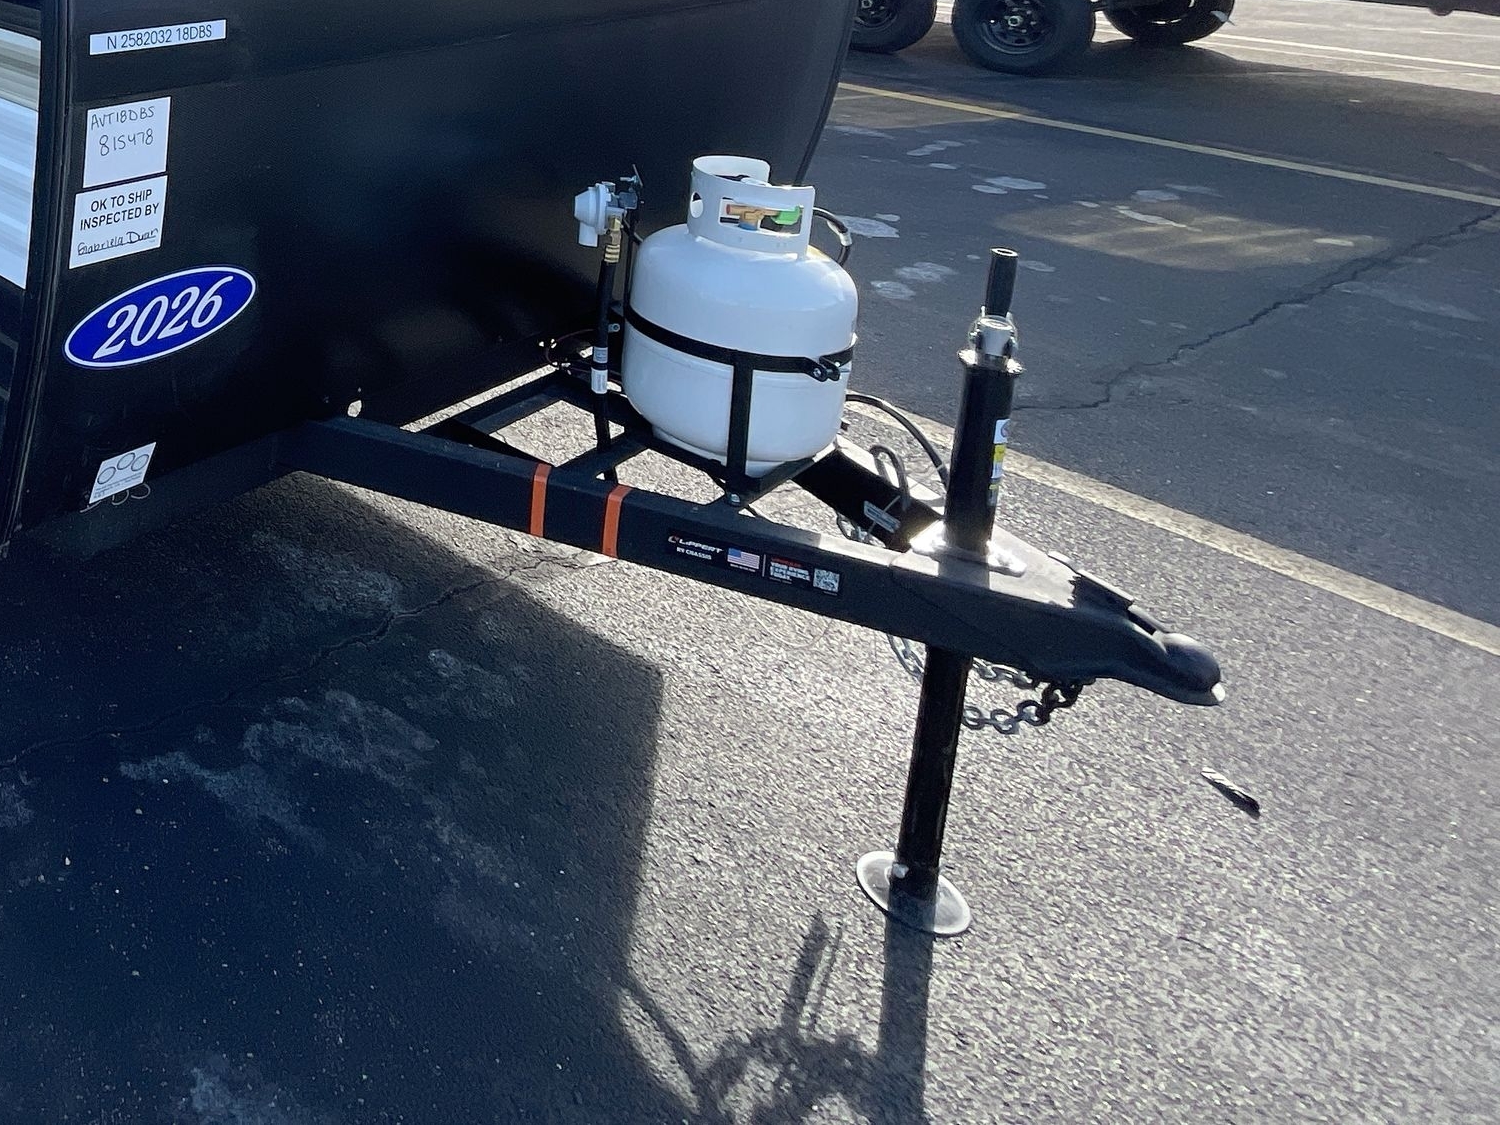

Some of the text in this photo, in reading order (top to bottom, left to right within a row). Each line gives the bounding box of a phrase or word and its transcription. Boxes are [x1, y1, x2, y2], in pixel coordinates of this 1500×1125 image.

[107, 25, 212, 50] N 2582032 18DBS
[91, 189, 152, 212] OK TO SHIP
[80, 202, 159, 231] INSPECTED BY
[93, 276, 234, 359] 2026
